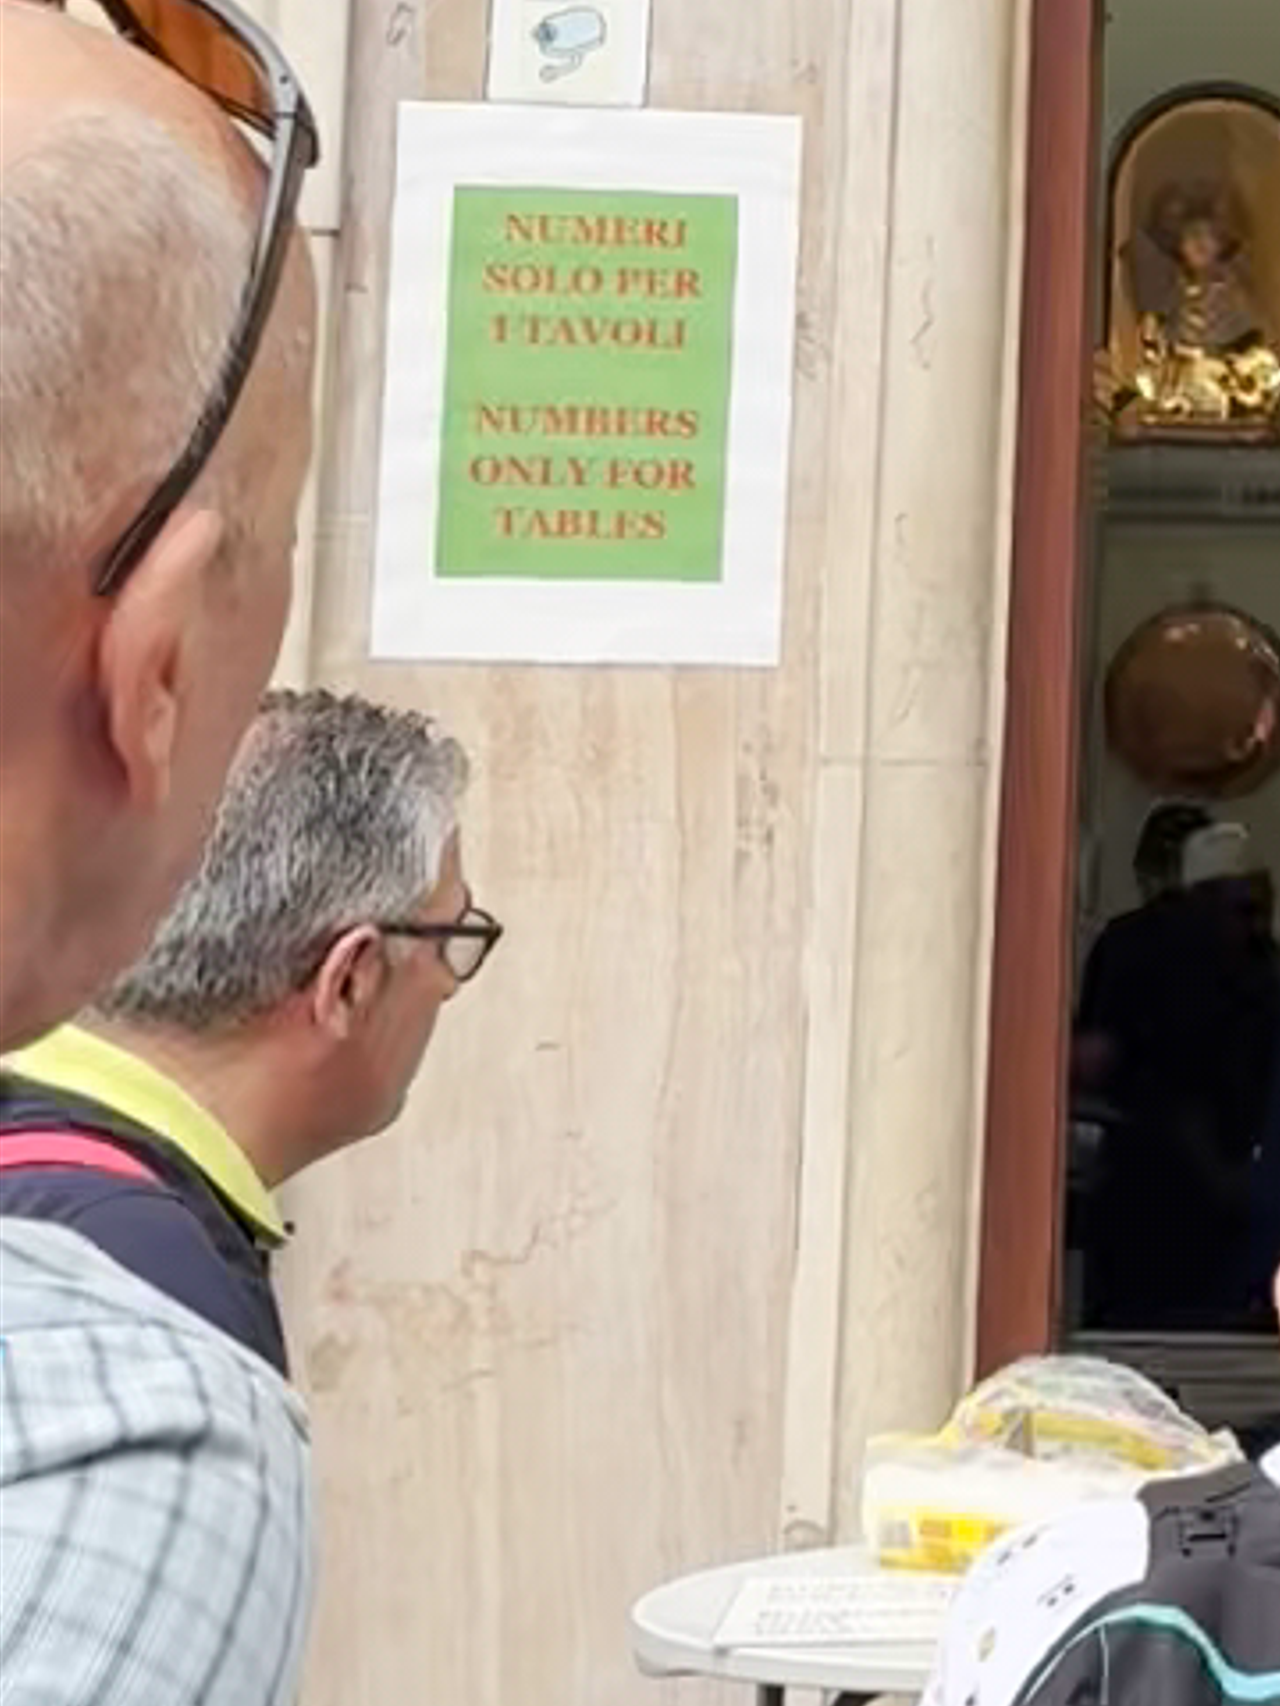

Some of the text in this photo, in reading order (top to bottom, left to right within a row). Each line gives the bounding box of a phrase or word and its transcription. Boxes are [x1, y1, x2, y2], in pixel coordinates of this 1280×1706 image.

[503, 212, 689, 251] NUMERI
[481, 262, 704, 301] SOLO PER
[518, 314, 689, 352] TAVOLI
[472, 403, 700, 442] NUMBERS
[468, 454, 698, 492] ONLY FOR
[494, 506, 668, 542] TABLES
